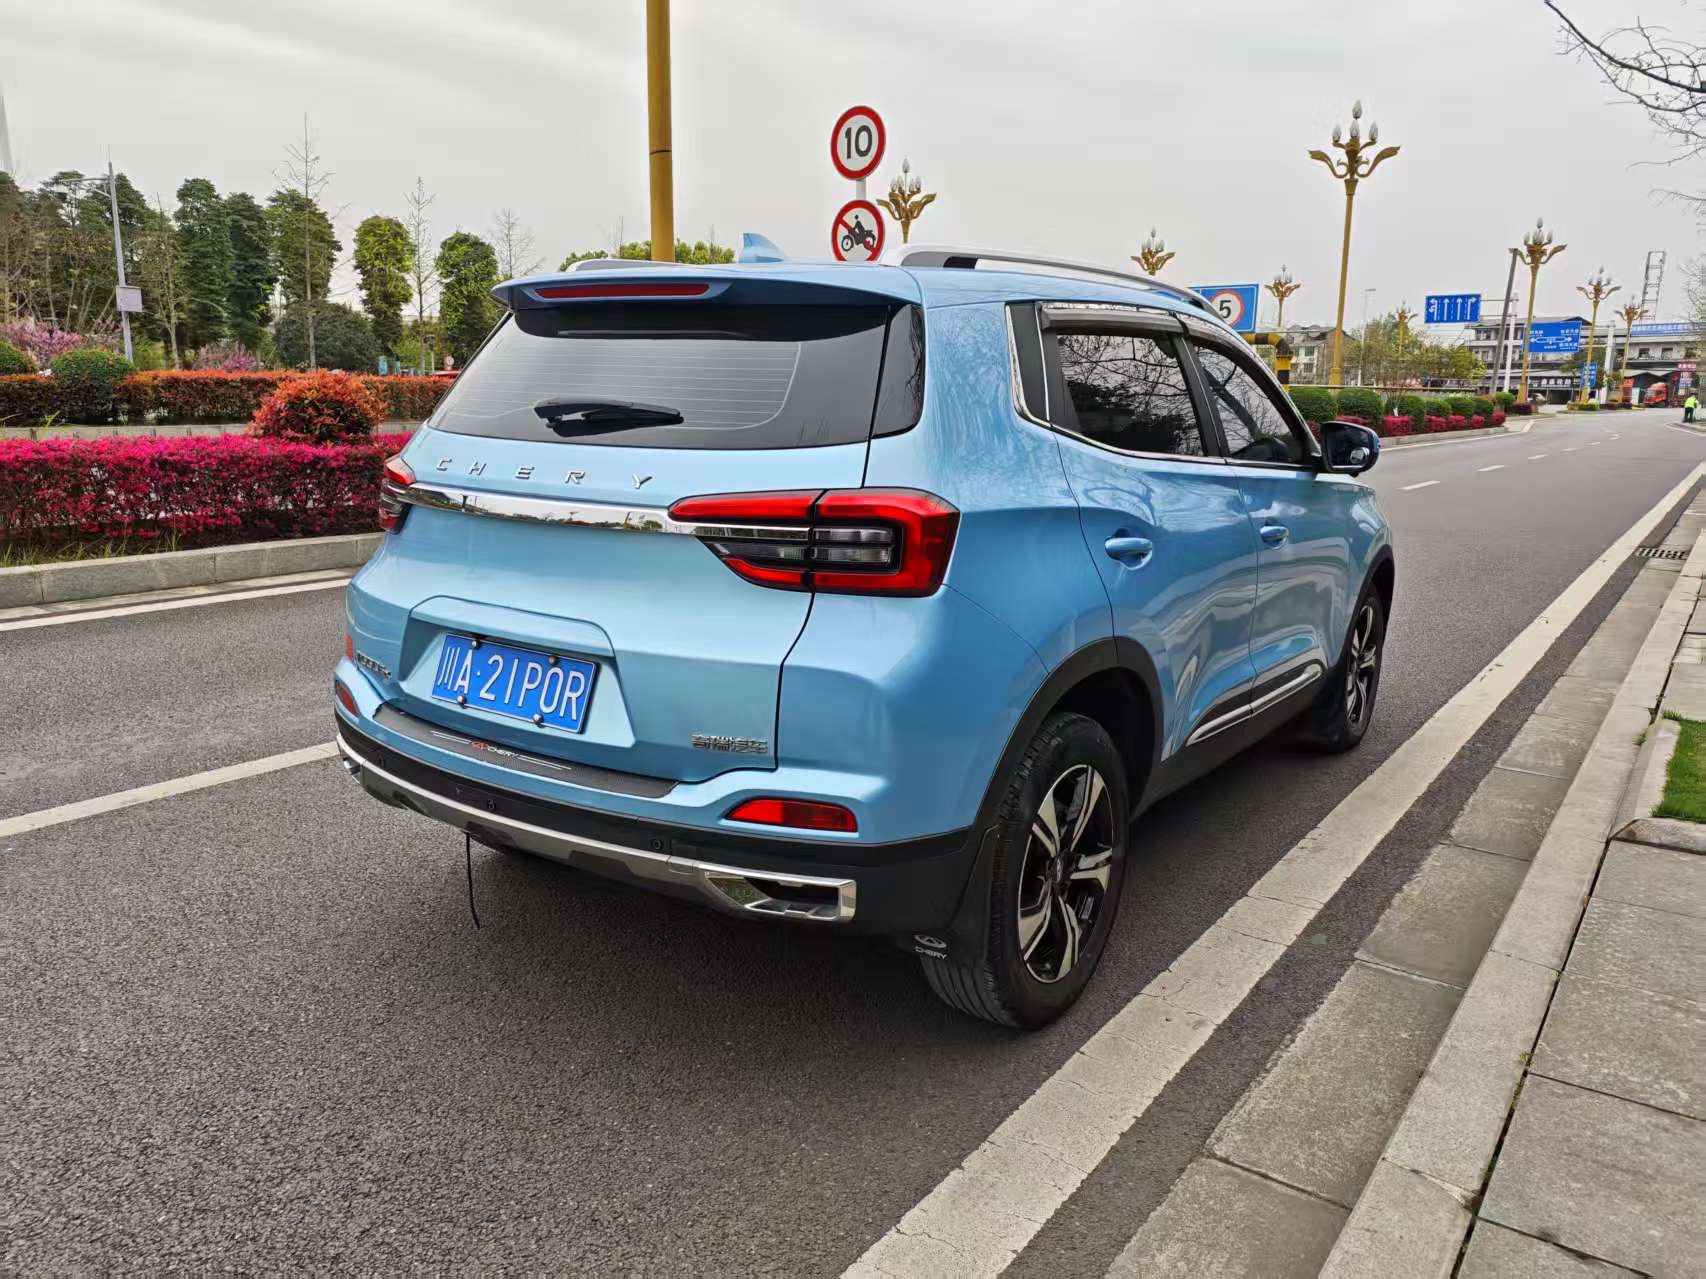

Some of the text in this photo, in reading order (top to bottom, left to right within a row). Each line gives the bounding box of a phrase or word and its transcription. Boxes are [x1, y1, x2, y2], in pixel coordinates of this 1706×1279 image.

[845, 125, 873, 159] 10
[1219, 299, 1232, 319] 5
[435, 457, 653, 490] CHERY
[914, 946, 948, 960] CHERY
